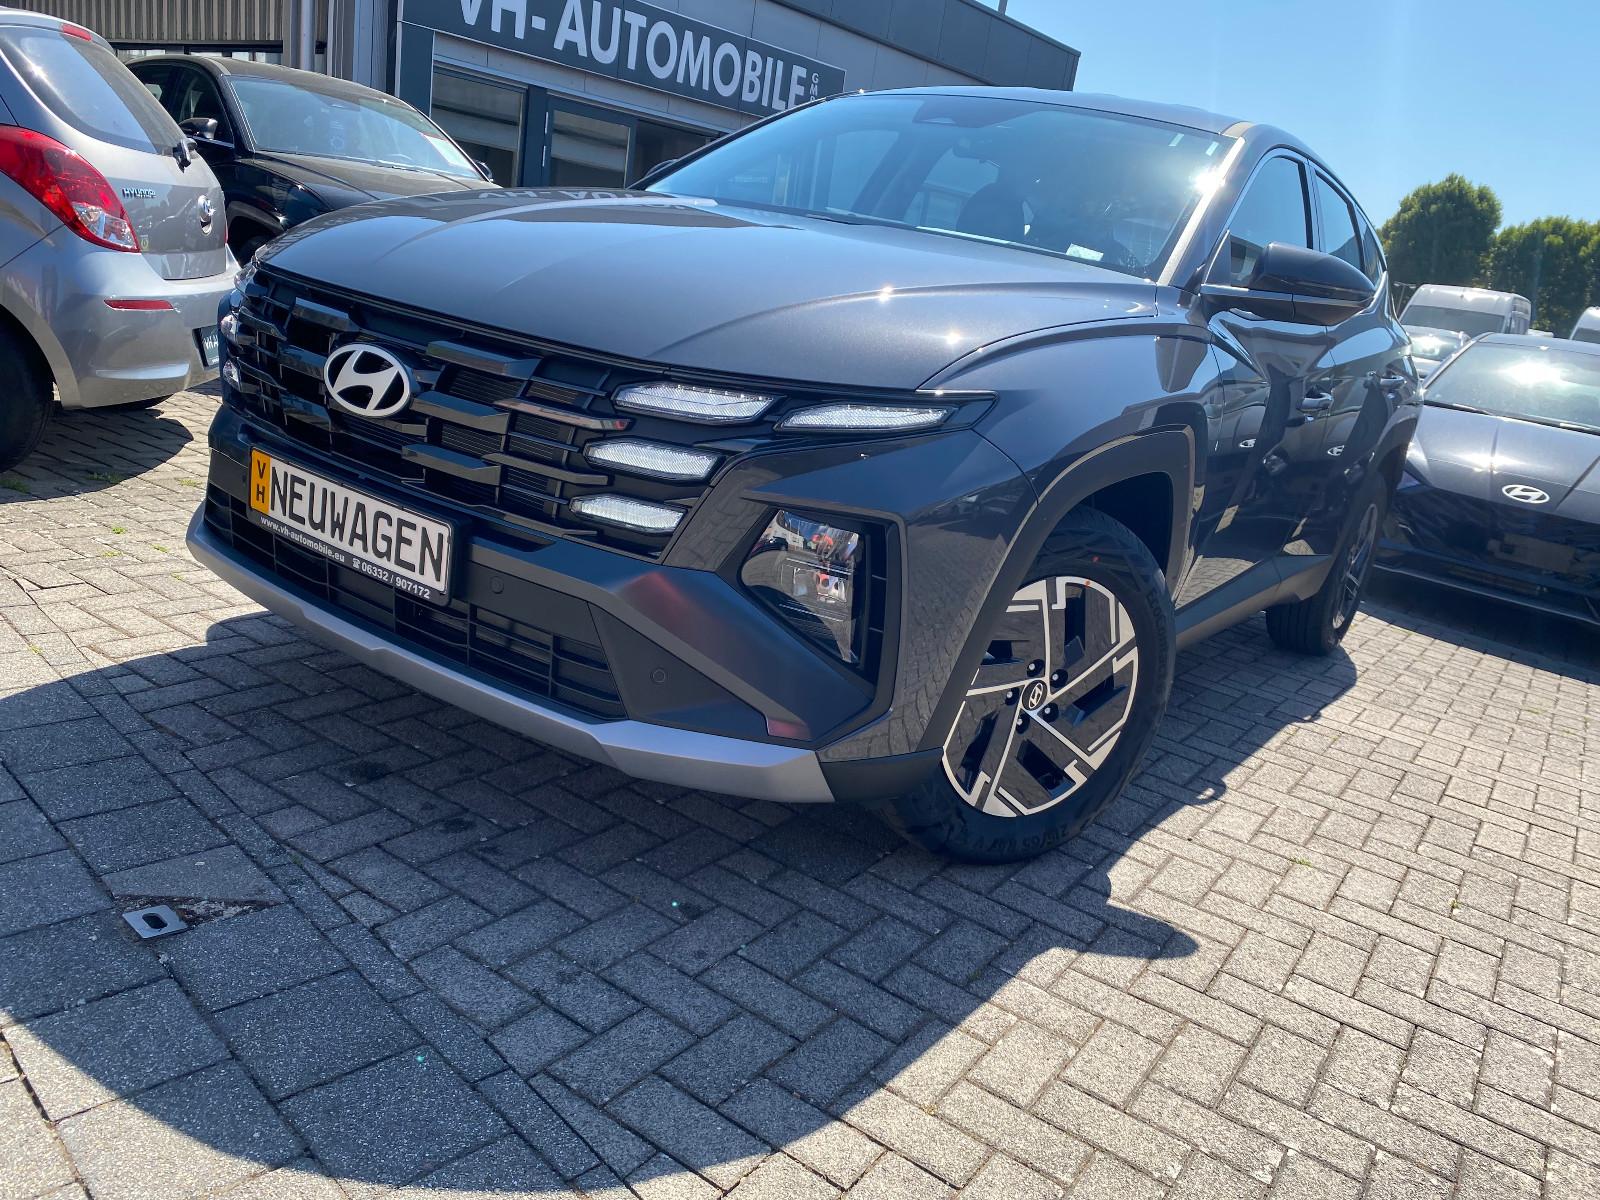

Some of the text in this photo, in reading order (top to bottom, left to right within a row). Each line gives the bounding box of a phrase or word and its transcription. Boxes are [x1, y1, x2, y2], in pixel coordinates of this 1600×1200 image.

[260, 516, 345, 563] www.vh-automobile.eu
[270, 466, 444, 582] NEUWAGEN
[361, 559, 389, 583] 06332
[395, 576, 431, 599] 907172
